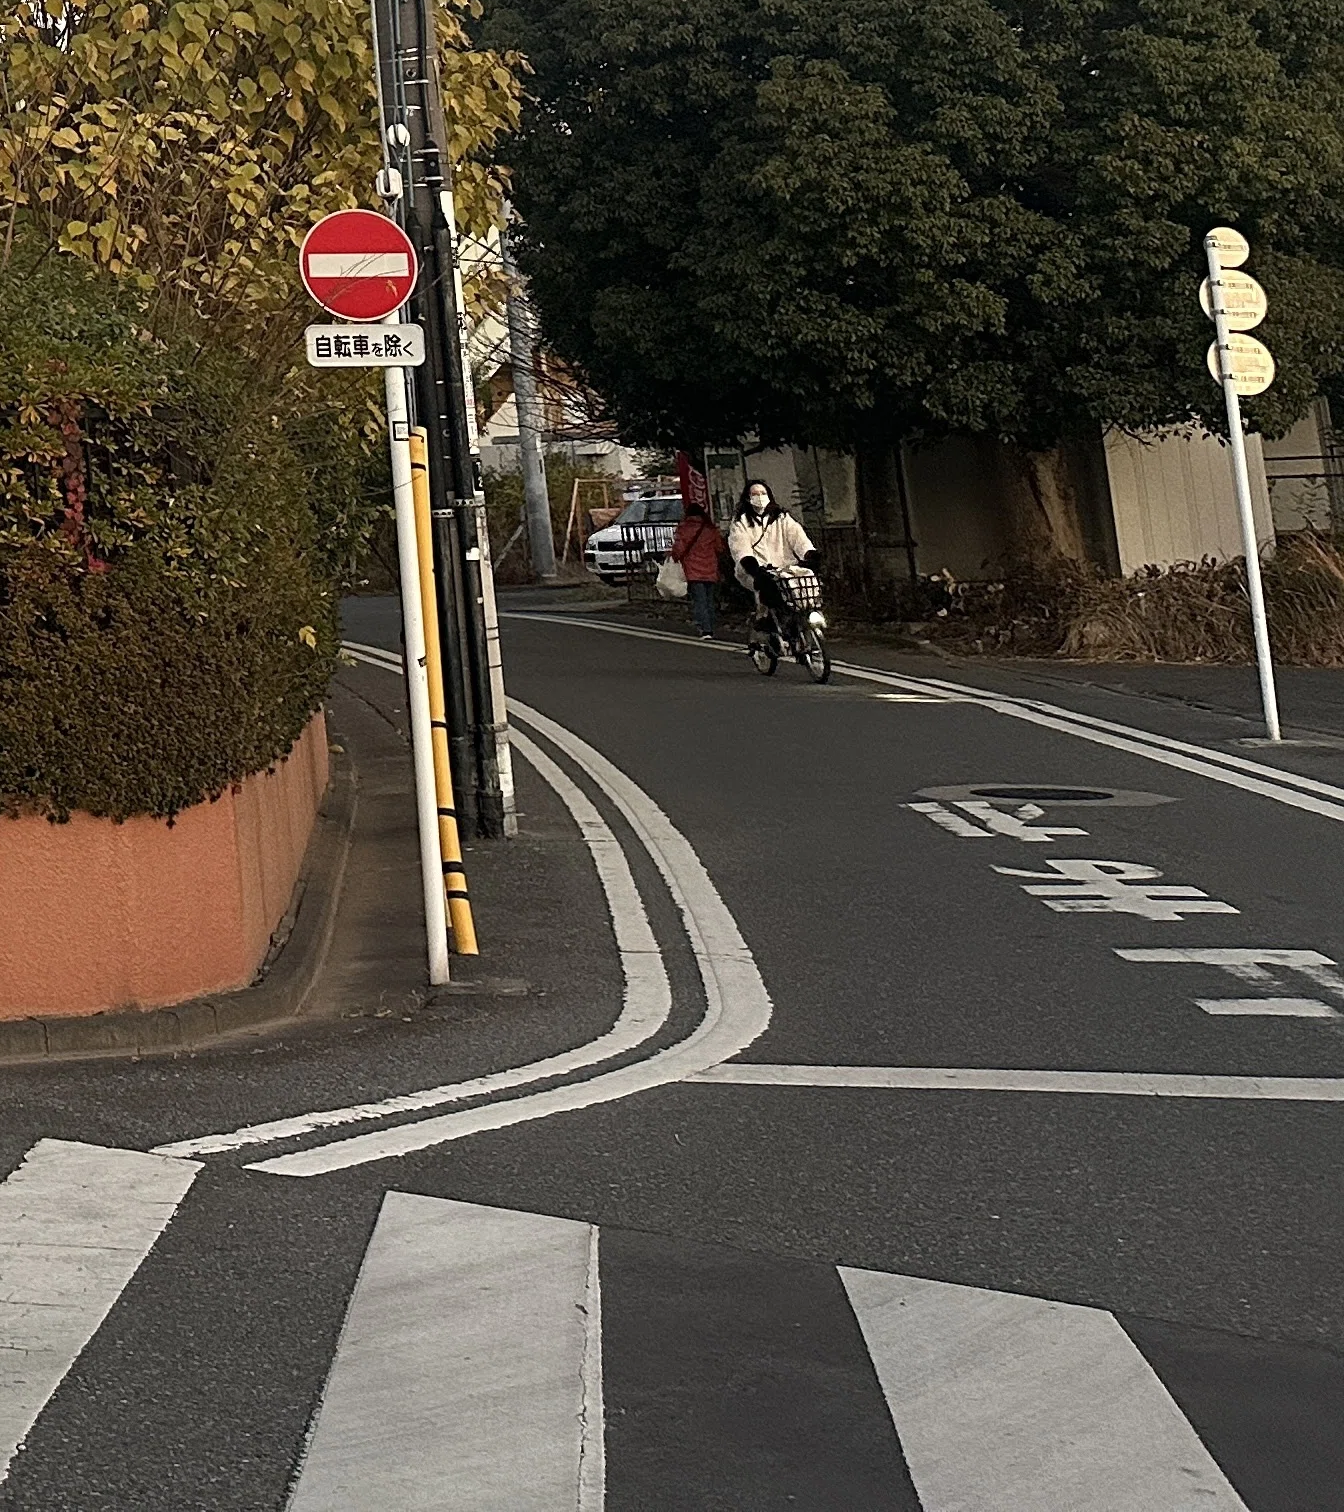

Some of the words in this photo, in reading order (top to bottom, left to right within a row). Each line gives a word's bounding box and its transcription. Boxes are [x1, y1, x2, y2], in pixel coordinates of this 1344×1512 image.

[315, 334, 415, 358] 自転車を除く
